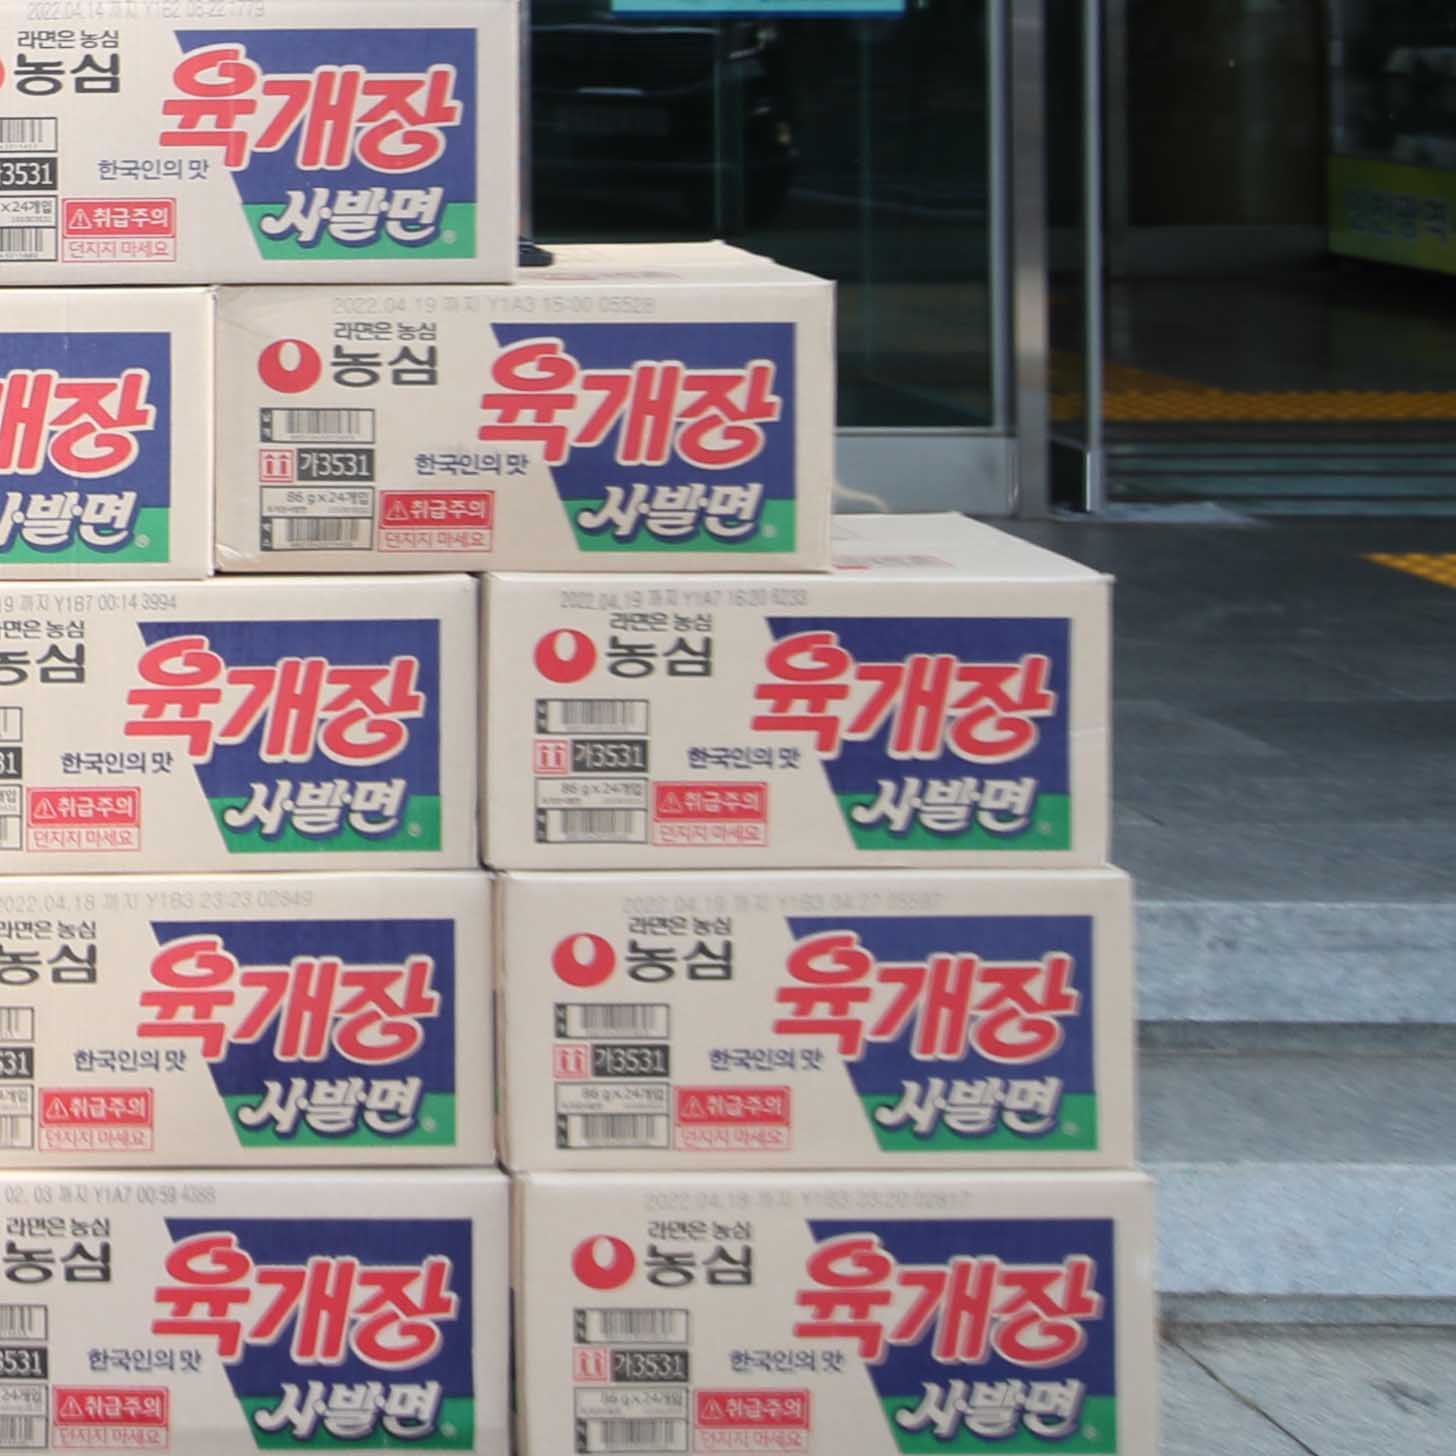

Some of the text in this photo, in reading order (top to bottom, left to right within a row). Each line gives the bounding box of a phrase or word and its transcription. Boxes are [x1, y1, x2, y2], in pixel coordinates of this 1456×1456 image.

[17, 29, 120, 49] 라면은 농심
[13, 53, 120, 96] 농심
[158, 45, 459, 172] 육개장
[98, 159, 209, 180] 한국인의 맛
[93, 208, 169, 228] 취급주의
[260, 187, 444, 245] 사발면
[69, 241, 169, 258] 던지지 마세요
[330, 345, 438, 389] 농심
[476, 339, 780, 469] 육개장
[578, 481, 763, 541] 사발면
[606, 635, 712, 679] 농심
[123, 636, 422, 765] 육개장
[750, 629, 1053, 762] 육개장
[224, 778, 406, 837] 사발면
[851, 774, 1037, 836] 사발면
[625, 939, 733, 983] 농심
[135, 936, 438, 1063] 육개장
[771, 932, 1077, 1063] 육개장
[238, 1077, 422, 1136] 사발면
[875, 1076, 1063, 1137] 사발면
[3, 1240, 111, 1285] 농심
[646, 1245, 753, 1288] 농심
[150, 1234, 457, 1368] 육개장
[792, 1237, 1098, 1365] 육개장
[254, 1379, 443, 1442] 사발면
[895, 1379, 1084, 1439] 사발면
